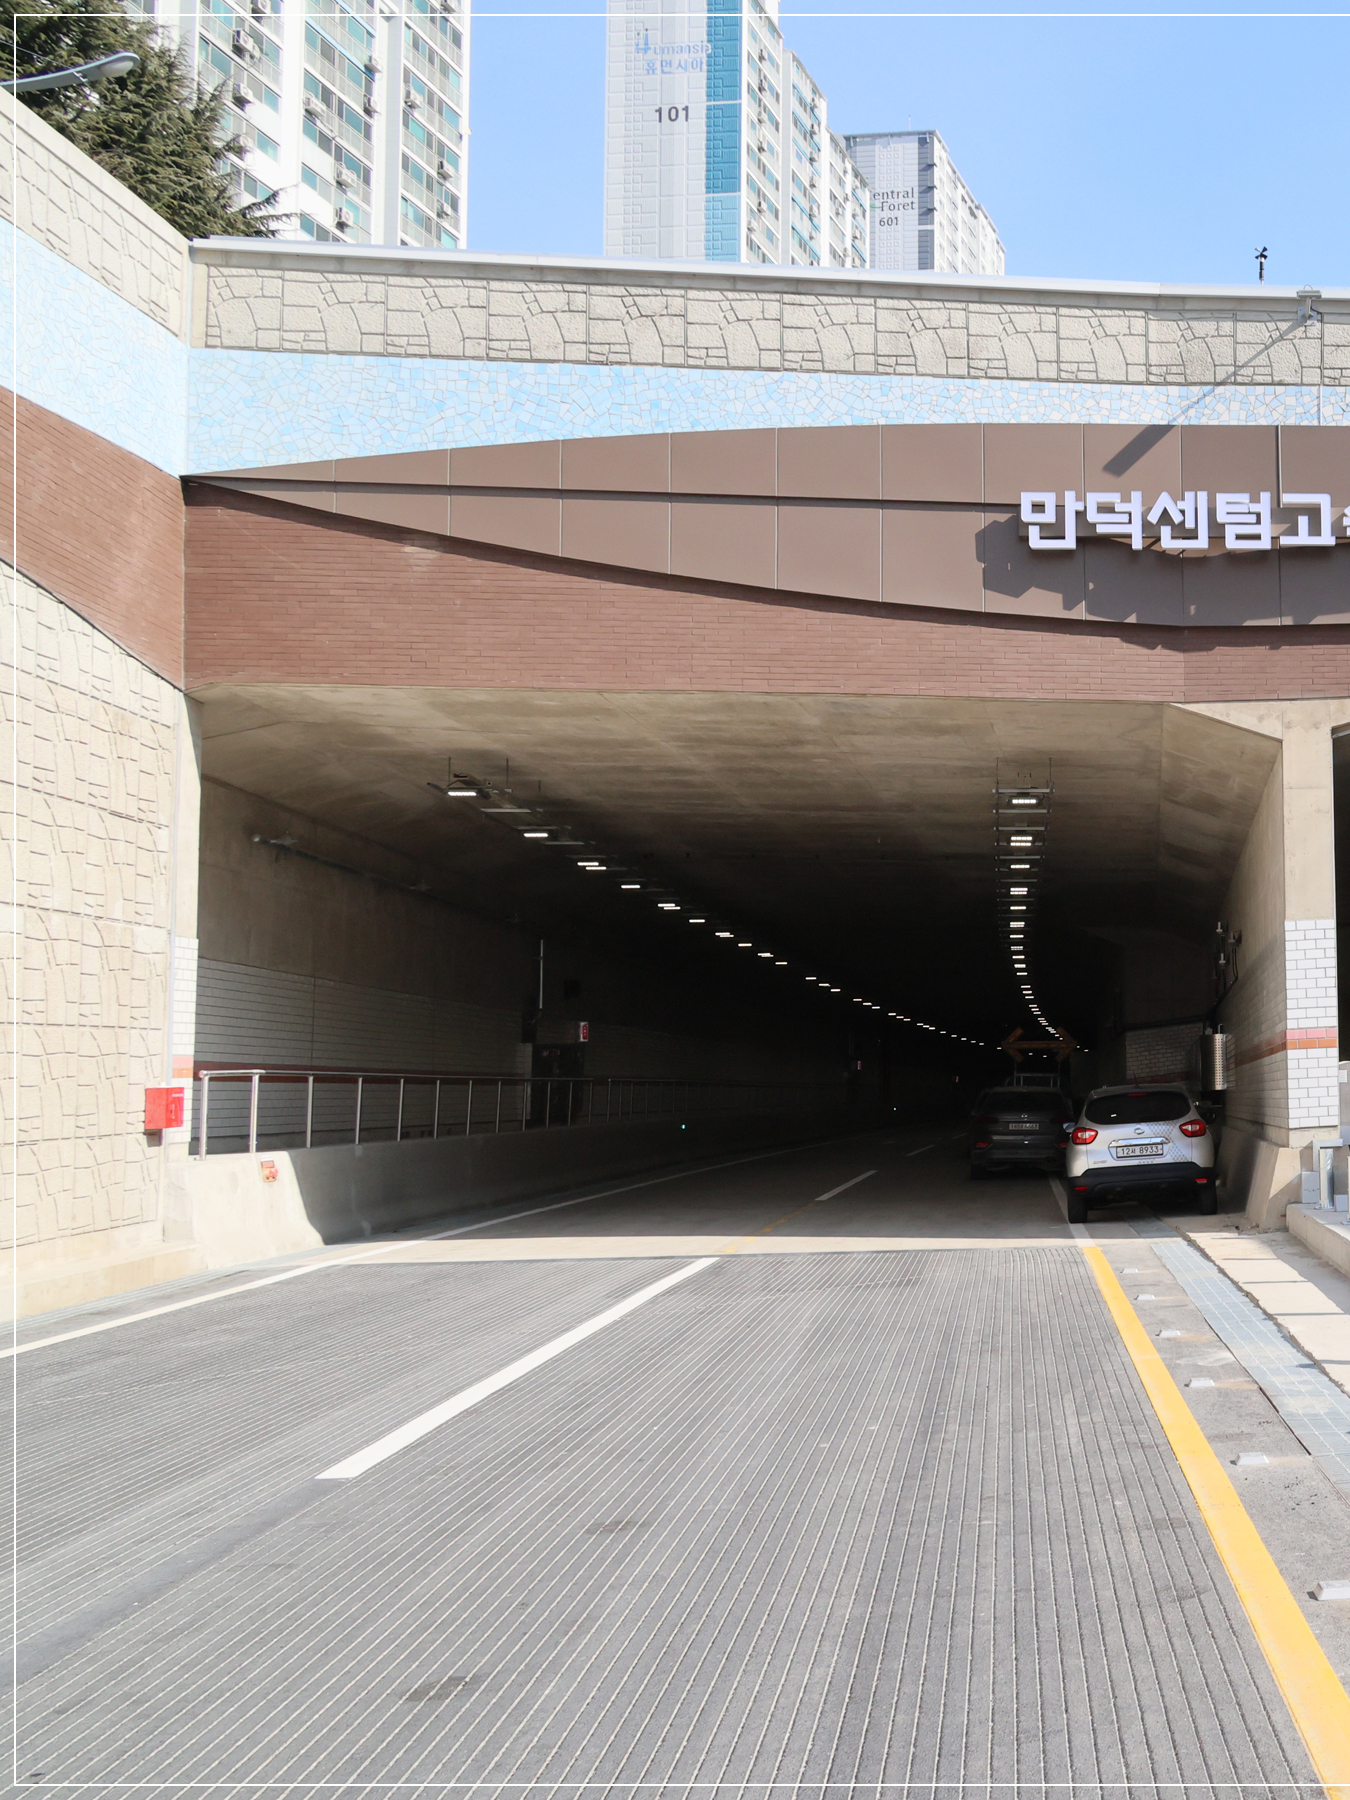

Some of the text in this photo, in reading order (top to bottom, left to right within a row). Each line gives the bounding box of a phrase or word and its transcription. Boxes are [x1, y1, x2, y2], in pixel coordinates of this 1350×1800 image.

[645, 58, 704, 75] 휴먼시아
[655, 105, 689, 123] 101
[872, 187, 914, 200] entral
[881, 200, 916, 212] Foret
[879, 216, 899, 227] 601
[1139, 1145, 1159, 1155] 8933
